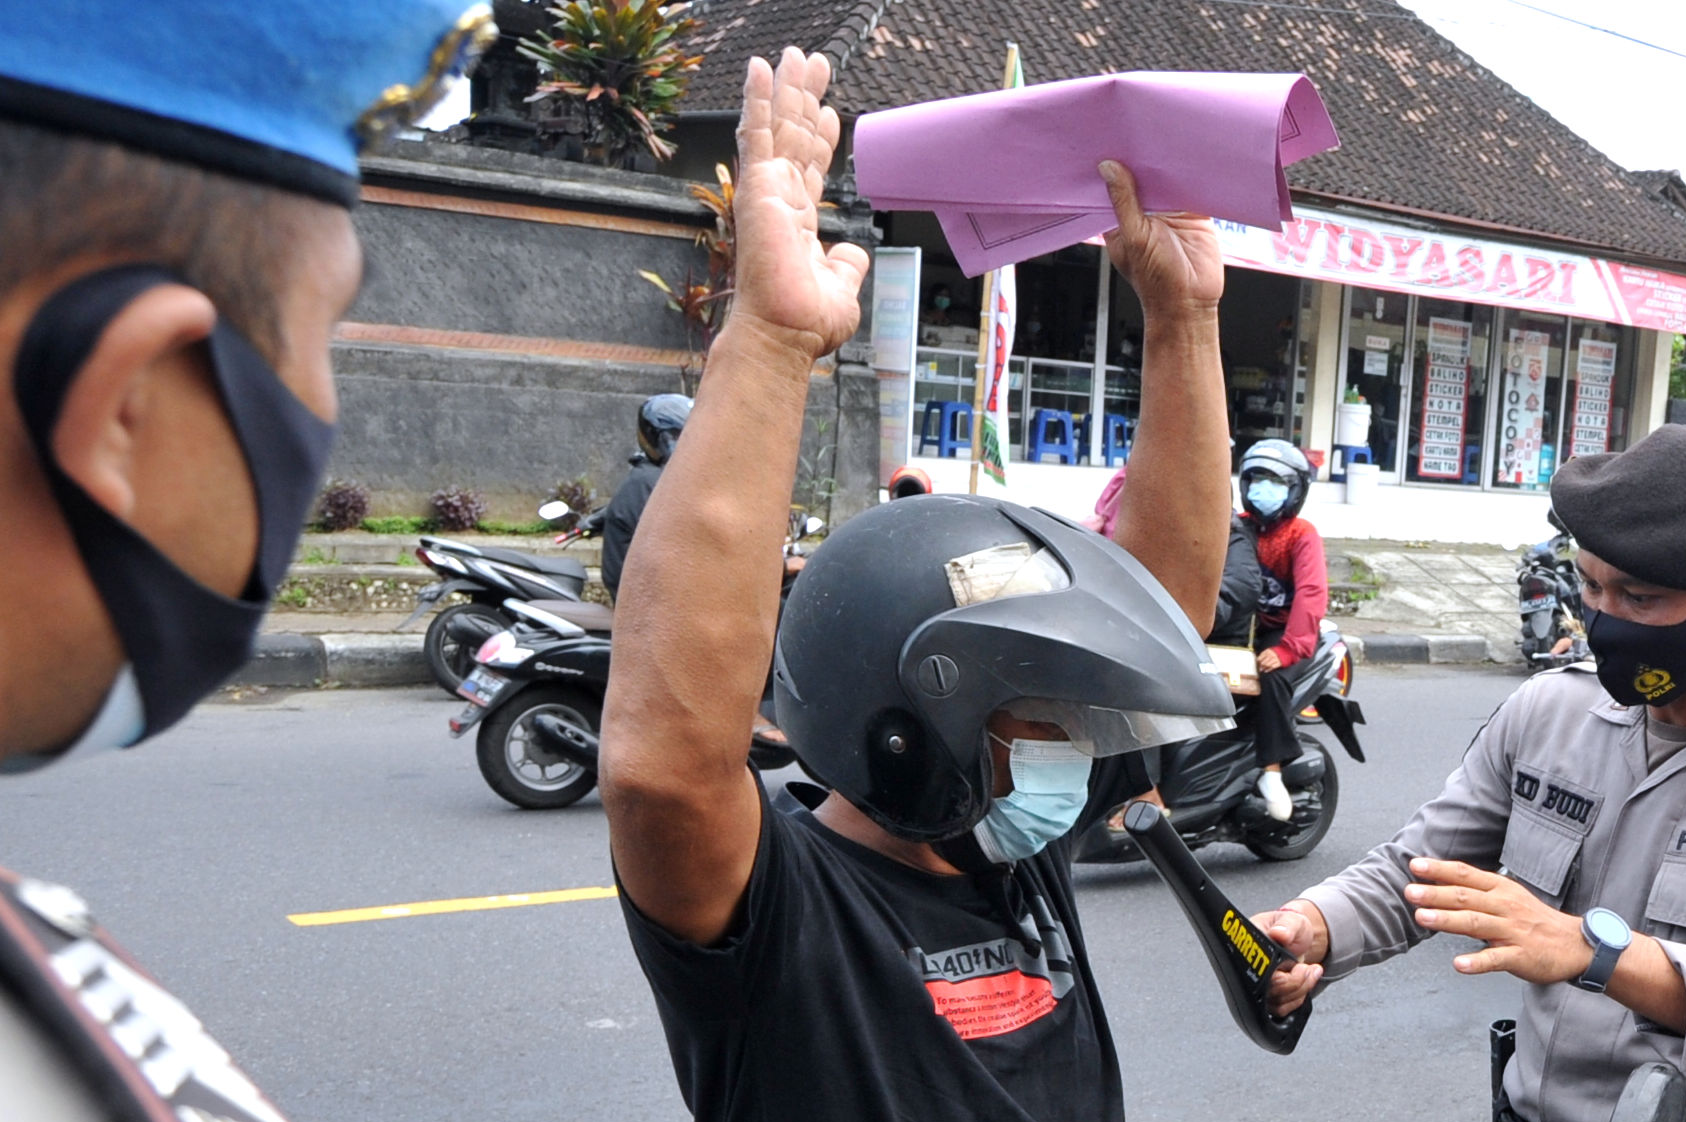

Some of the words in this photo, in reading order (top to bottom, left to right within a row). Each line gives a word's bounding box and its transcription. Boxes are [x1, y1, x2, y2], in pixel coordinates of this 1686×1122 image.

[1271, 217, 1577, 305] WIDYASARI
[1429, 383, 1463, 396] STICKER
[1578, 400, 1608, 412] STICKER
[1427, 414, 1460, 427] STEMPEL
[1575, 429, 1605, 441] STEMPEL
[1645, 682, 1676, 700] POLRI
[1542, 784, 1594, 825] BUDI
[1222, 909, 1270, 976] GARRETT
